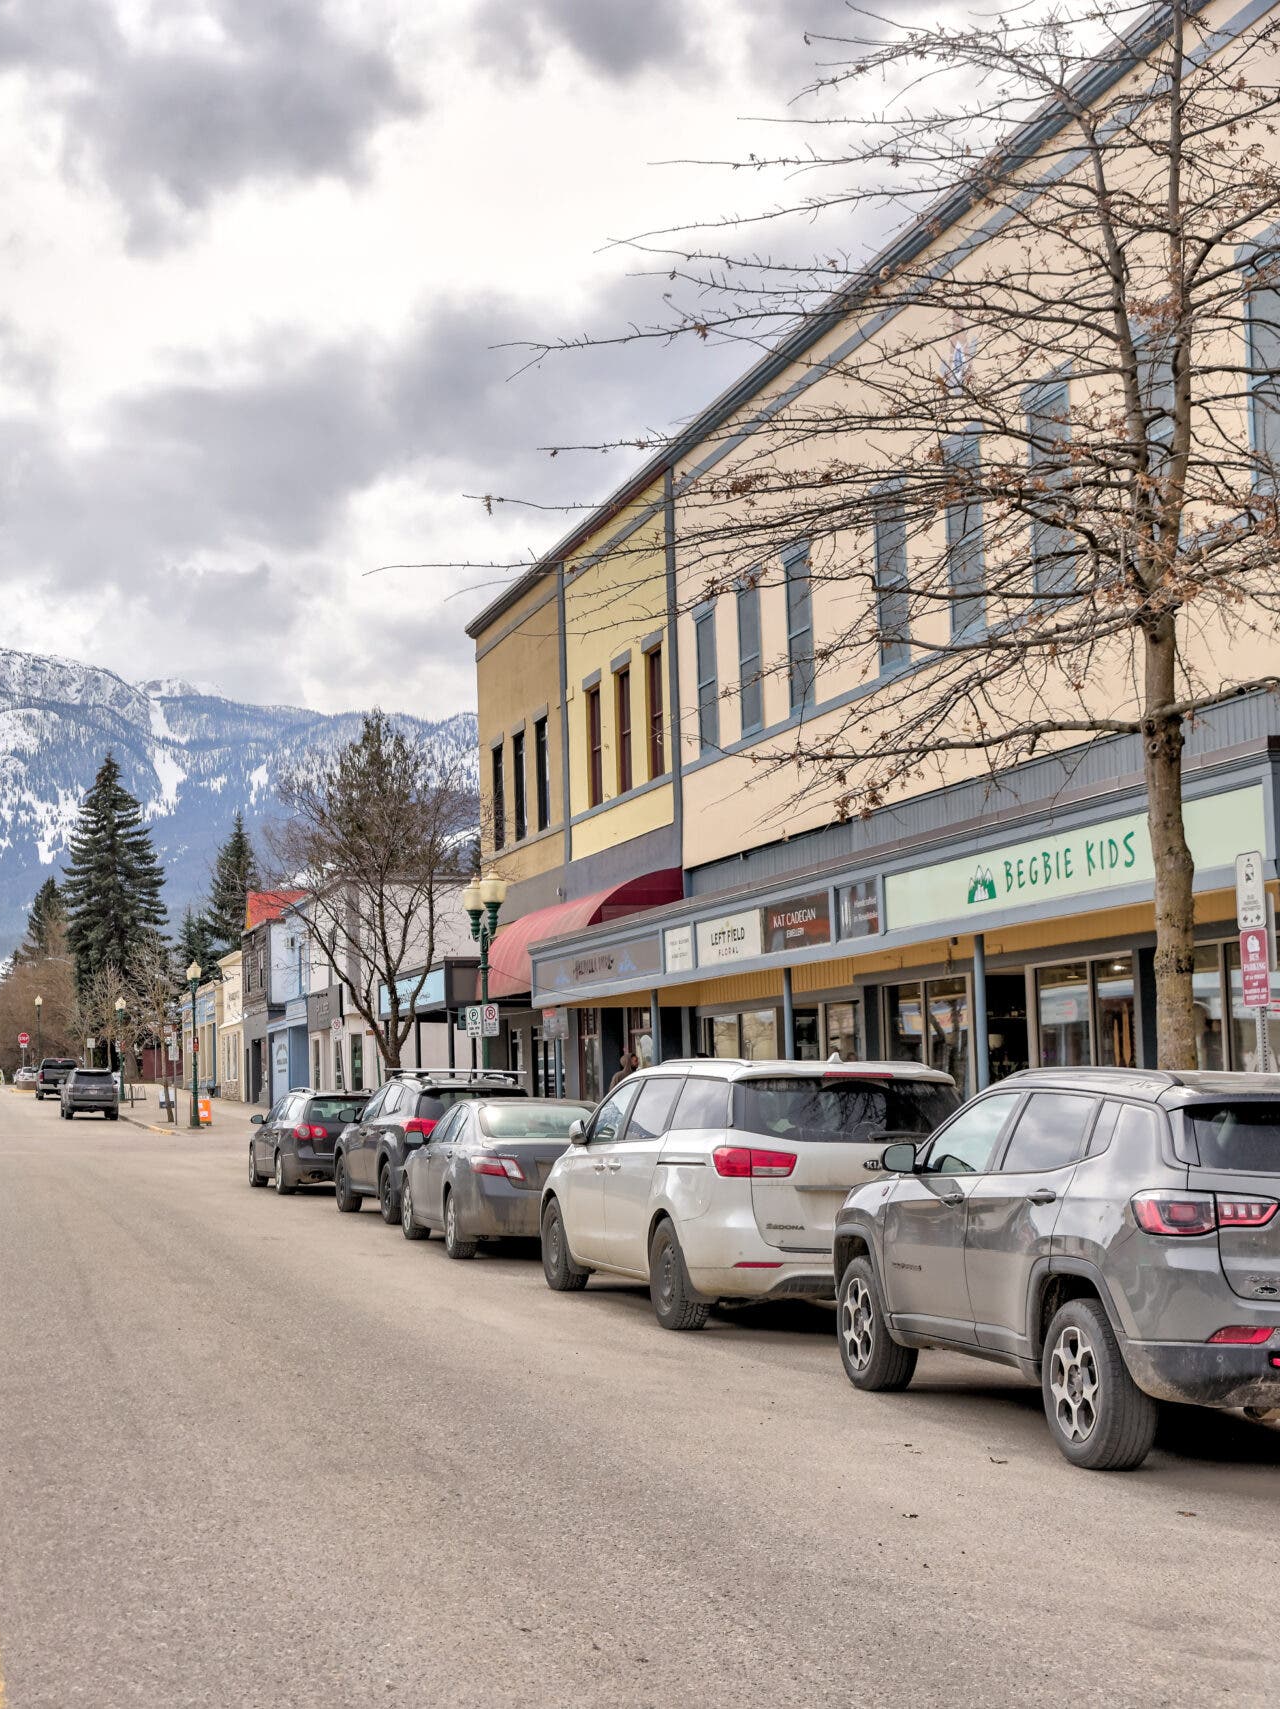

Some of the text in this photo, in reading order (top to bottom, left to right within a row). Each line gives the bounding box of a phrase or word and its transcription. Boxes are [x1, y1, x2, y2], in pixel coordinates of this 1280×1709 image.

[1004, 831, 1135, 893] BEGBIE KIDS
[773, 908, 816, 928] KAT CADEGAN
[710, 927, 745, 946] LEFT FIELD
[719, 948, 739, 957] FLORAL
[766, 1222, 806, 1231] SEDONA
